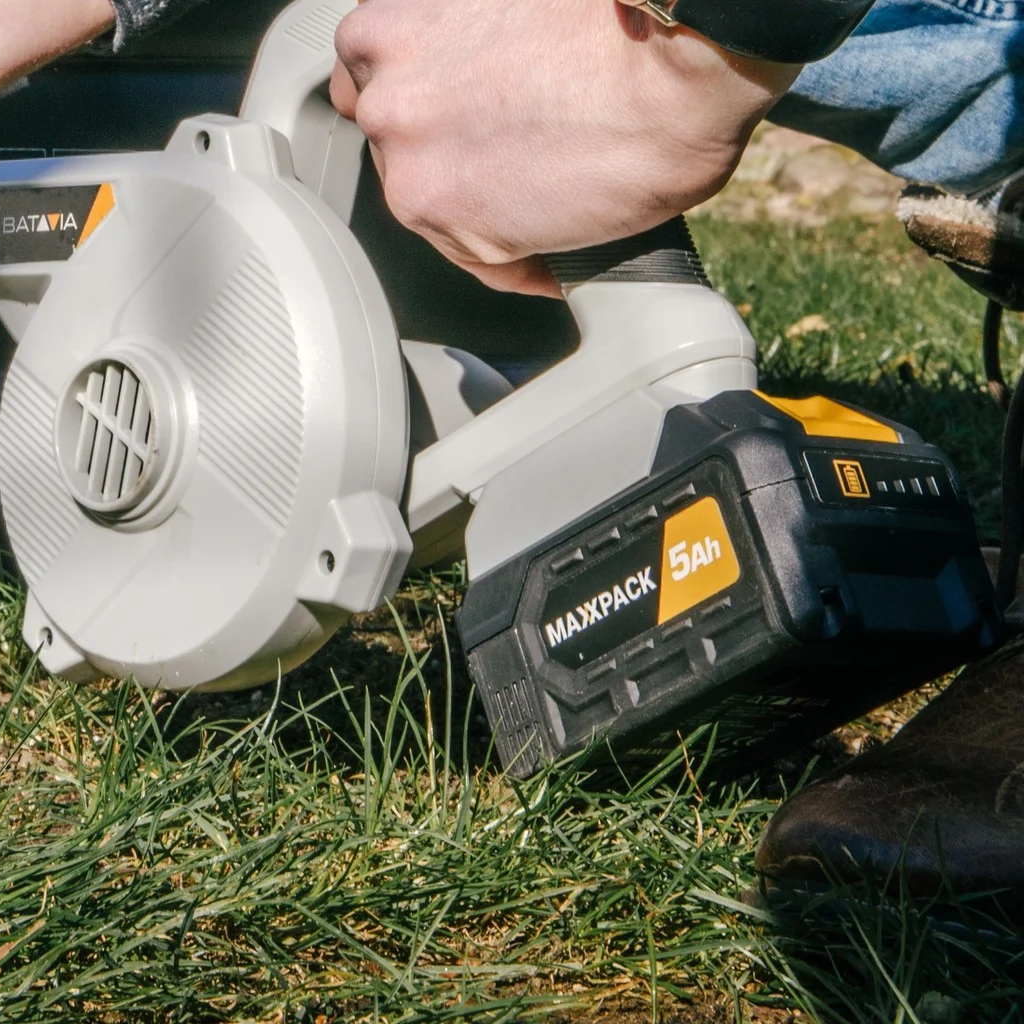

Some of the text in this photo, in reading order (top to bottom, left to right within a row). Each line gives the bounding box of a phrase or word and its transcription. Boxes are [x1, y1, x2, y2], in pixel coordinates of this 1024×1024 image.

[2, 212, 78, 234] BATAVIA
[668, 536, 722, 582] 5Ah
[544, 566, 658, 649] MAXXPACK
